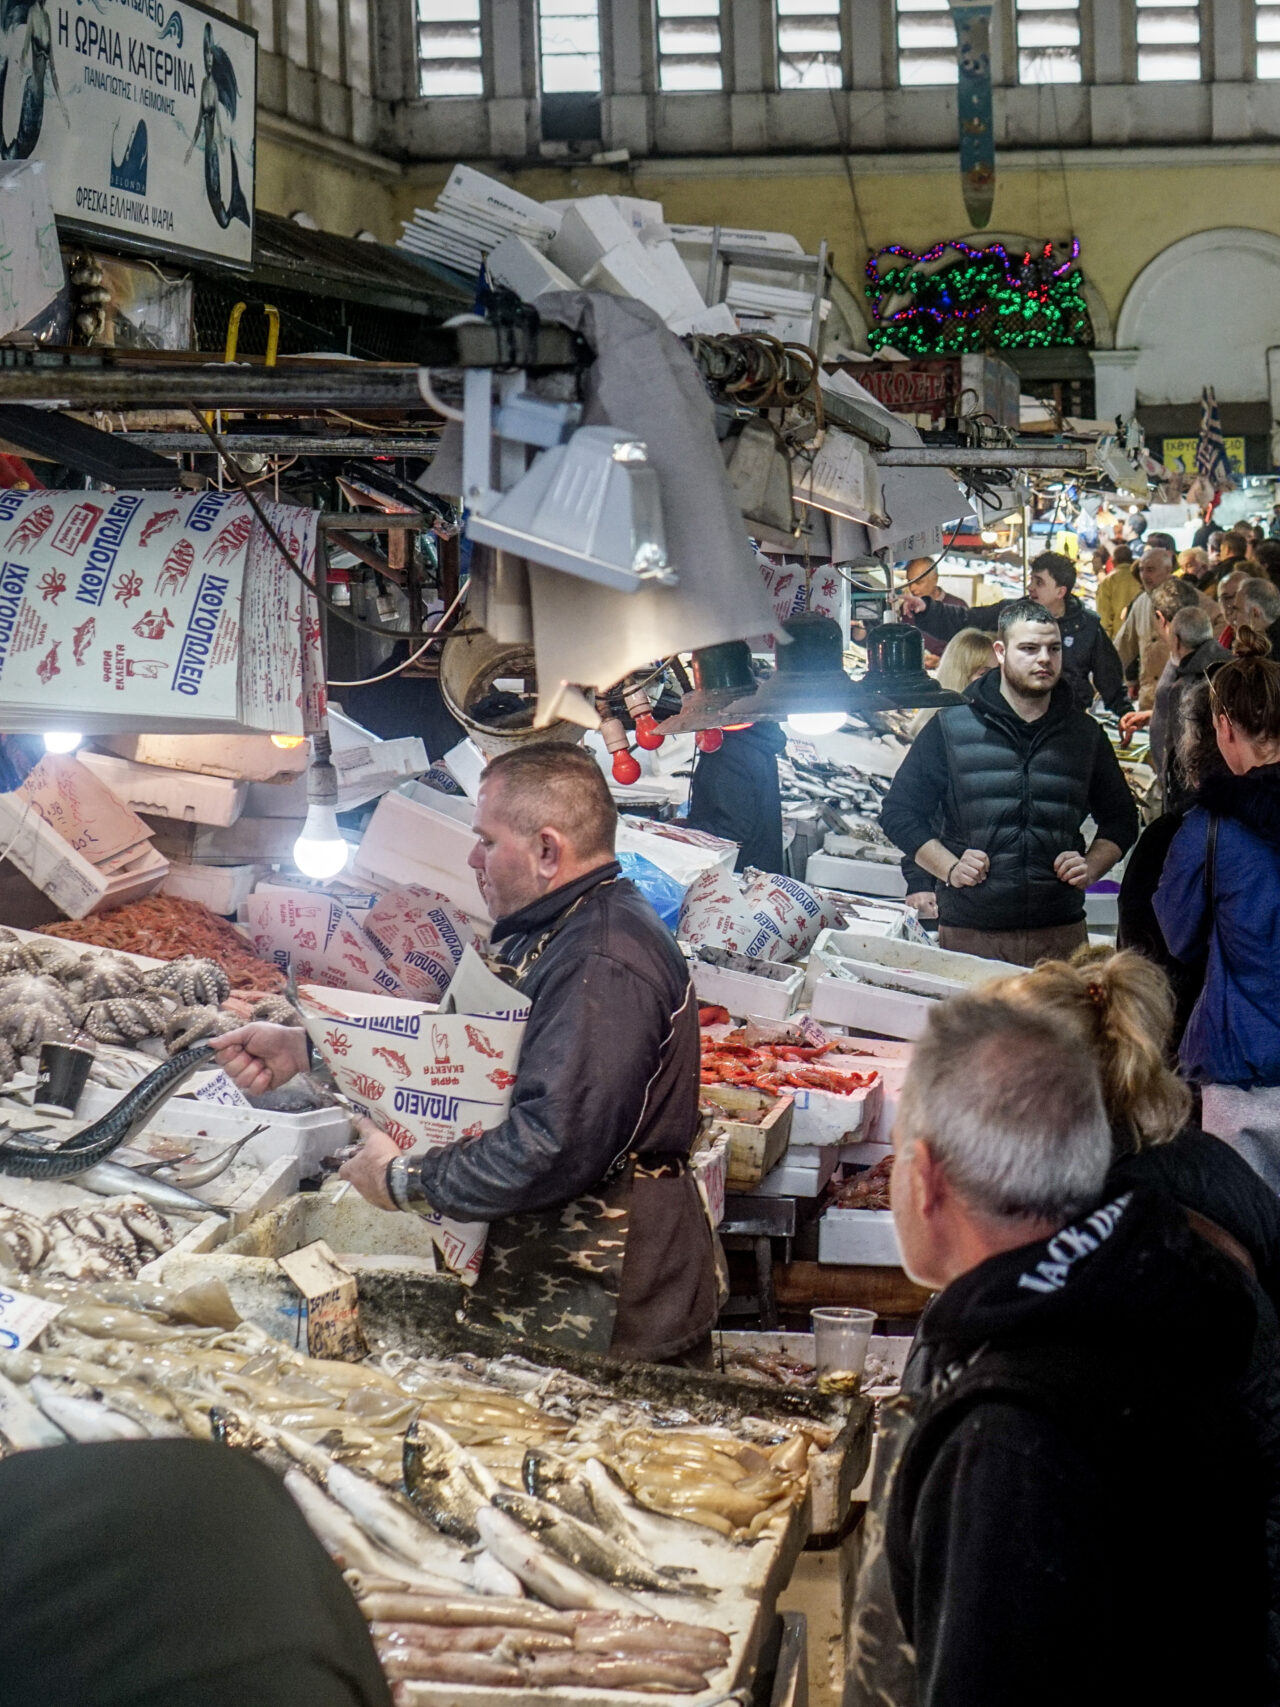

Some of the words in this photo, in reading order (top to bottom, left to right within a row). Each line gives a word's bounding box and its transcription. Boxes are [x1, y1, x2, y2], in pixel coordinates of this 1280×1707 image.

[58, 8, 69, 48] Η
[75, 16, 124, 69] ΩΡΑΙΑ
[128, 37, 197, 98] ΚΑΤΕΡΙΝΑ
[84, 66, 132, 101] ΠΑΝΑΓΙΩΤΗΣ
[76, 186, 108, 215] ΦΡΕΣΚΑ
[110, 195, 150, 226] ΕΛΛΗΝΙΚΑ
[151, 207, 175, 232] ΨΑΡΙΑ
[75, 494, 138, 606] ΙΧΘΥΟΠΩΛΕΙΟ
[177, 574, 230, 696] ΙΧΘΥΟΠΩΛΕΙΟ
[115, 644, 126, 691] ΕΚΛΕΚΤΑ
[770, 874, 821, 919] ΙΧΘΥΟΠΩΛΕΙΟ
